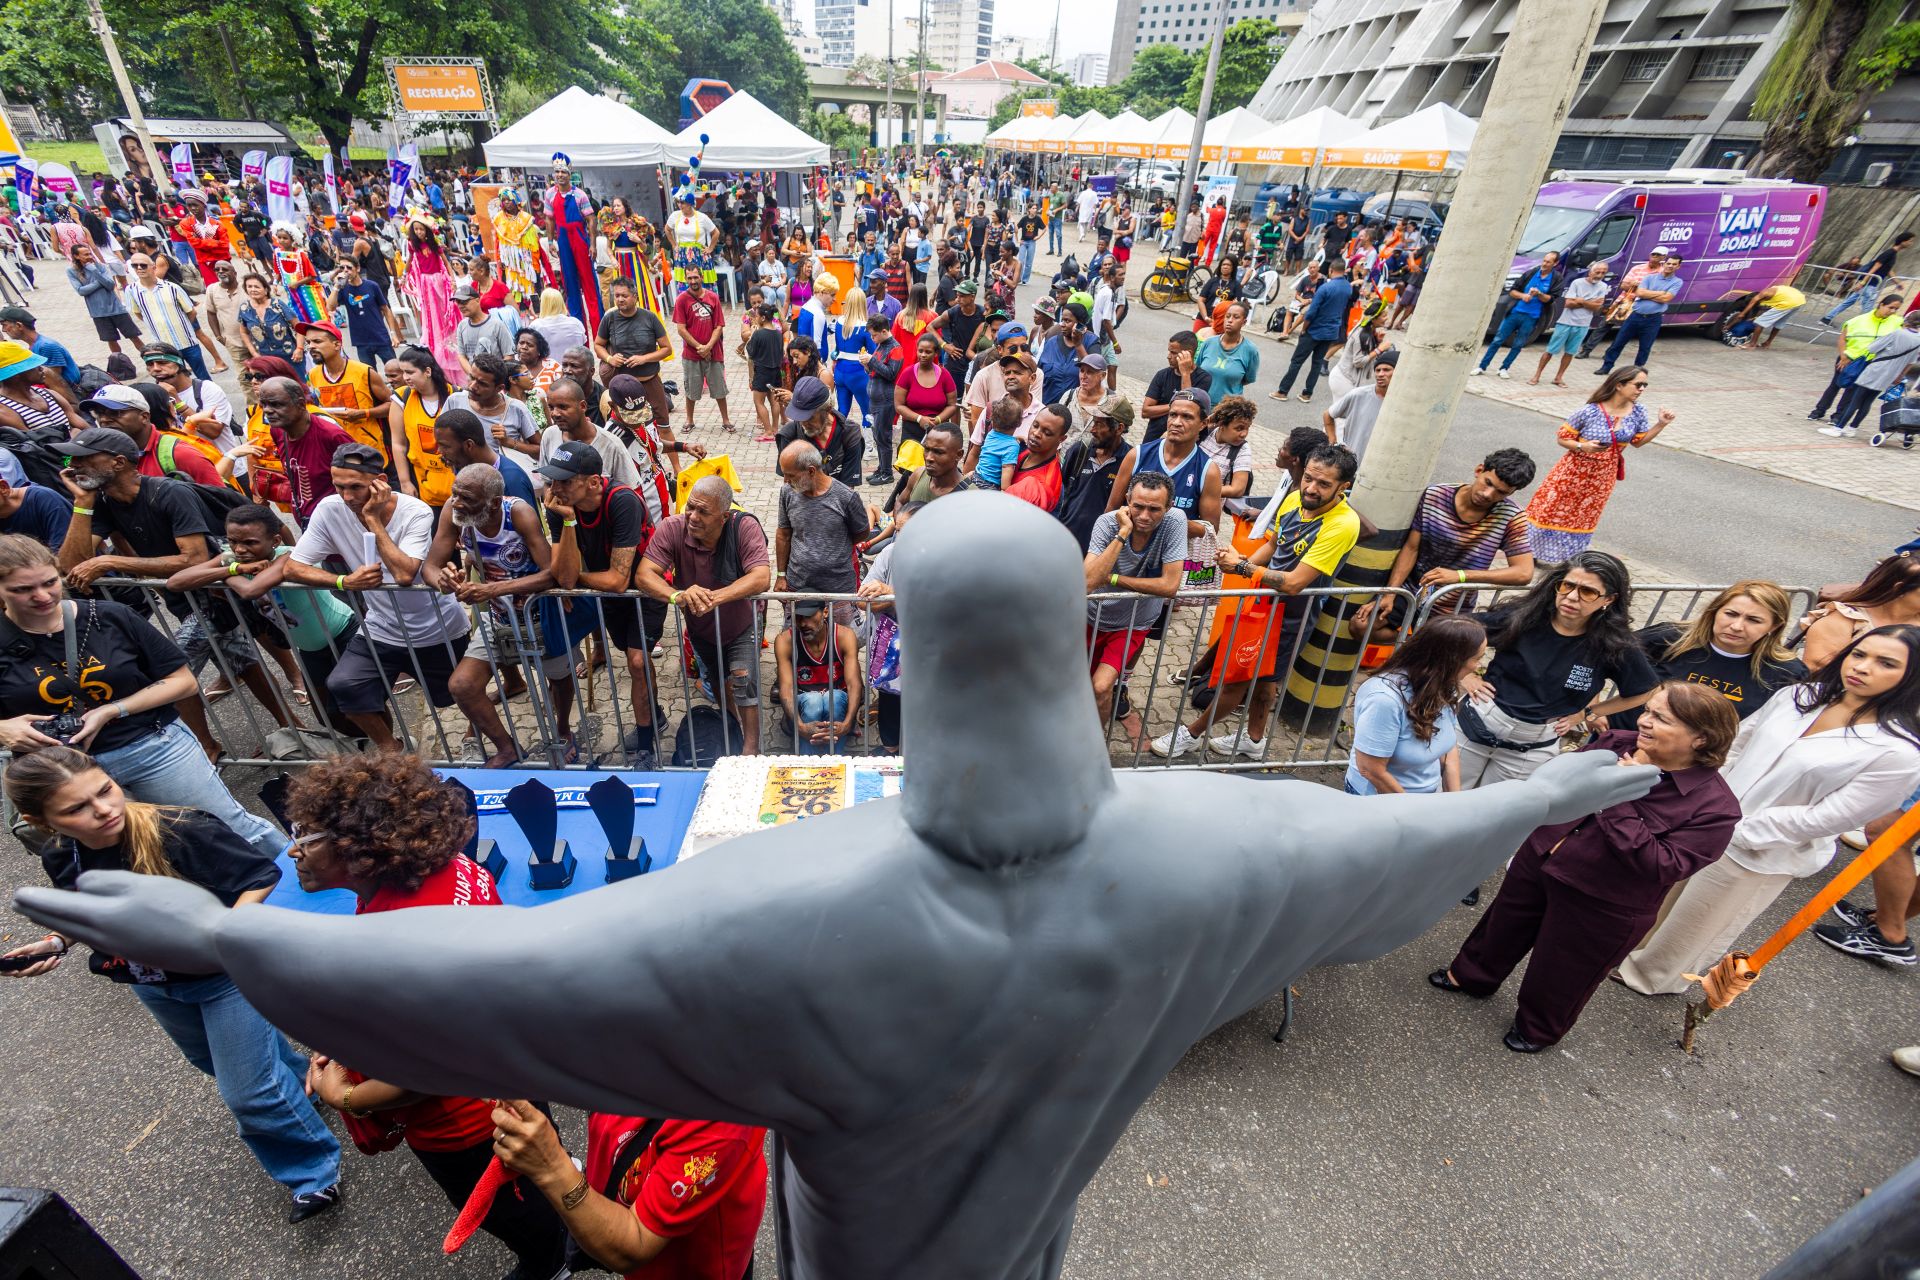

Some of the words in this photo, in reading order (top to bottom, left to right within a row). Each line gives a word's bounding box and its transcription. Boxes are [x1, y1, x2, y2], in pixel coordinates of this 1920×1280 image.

[407, 85, 476, 100] RECREAÇÃO
[1256, 148, 1285, 161] SAÚDE
[1363, 150, 1403, 165] SAÚDE
[1719, 206, 1769, 235] VAN
[1669, 227, 1693, 241] RIO
[1718, 233, 1762, 253] BORA!
[1712, 261, 1730, 272] SAÚDE
[1687, 672, 1743, 696] FESTA
[781, 794, 831, 815] 95
